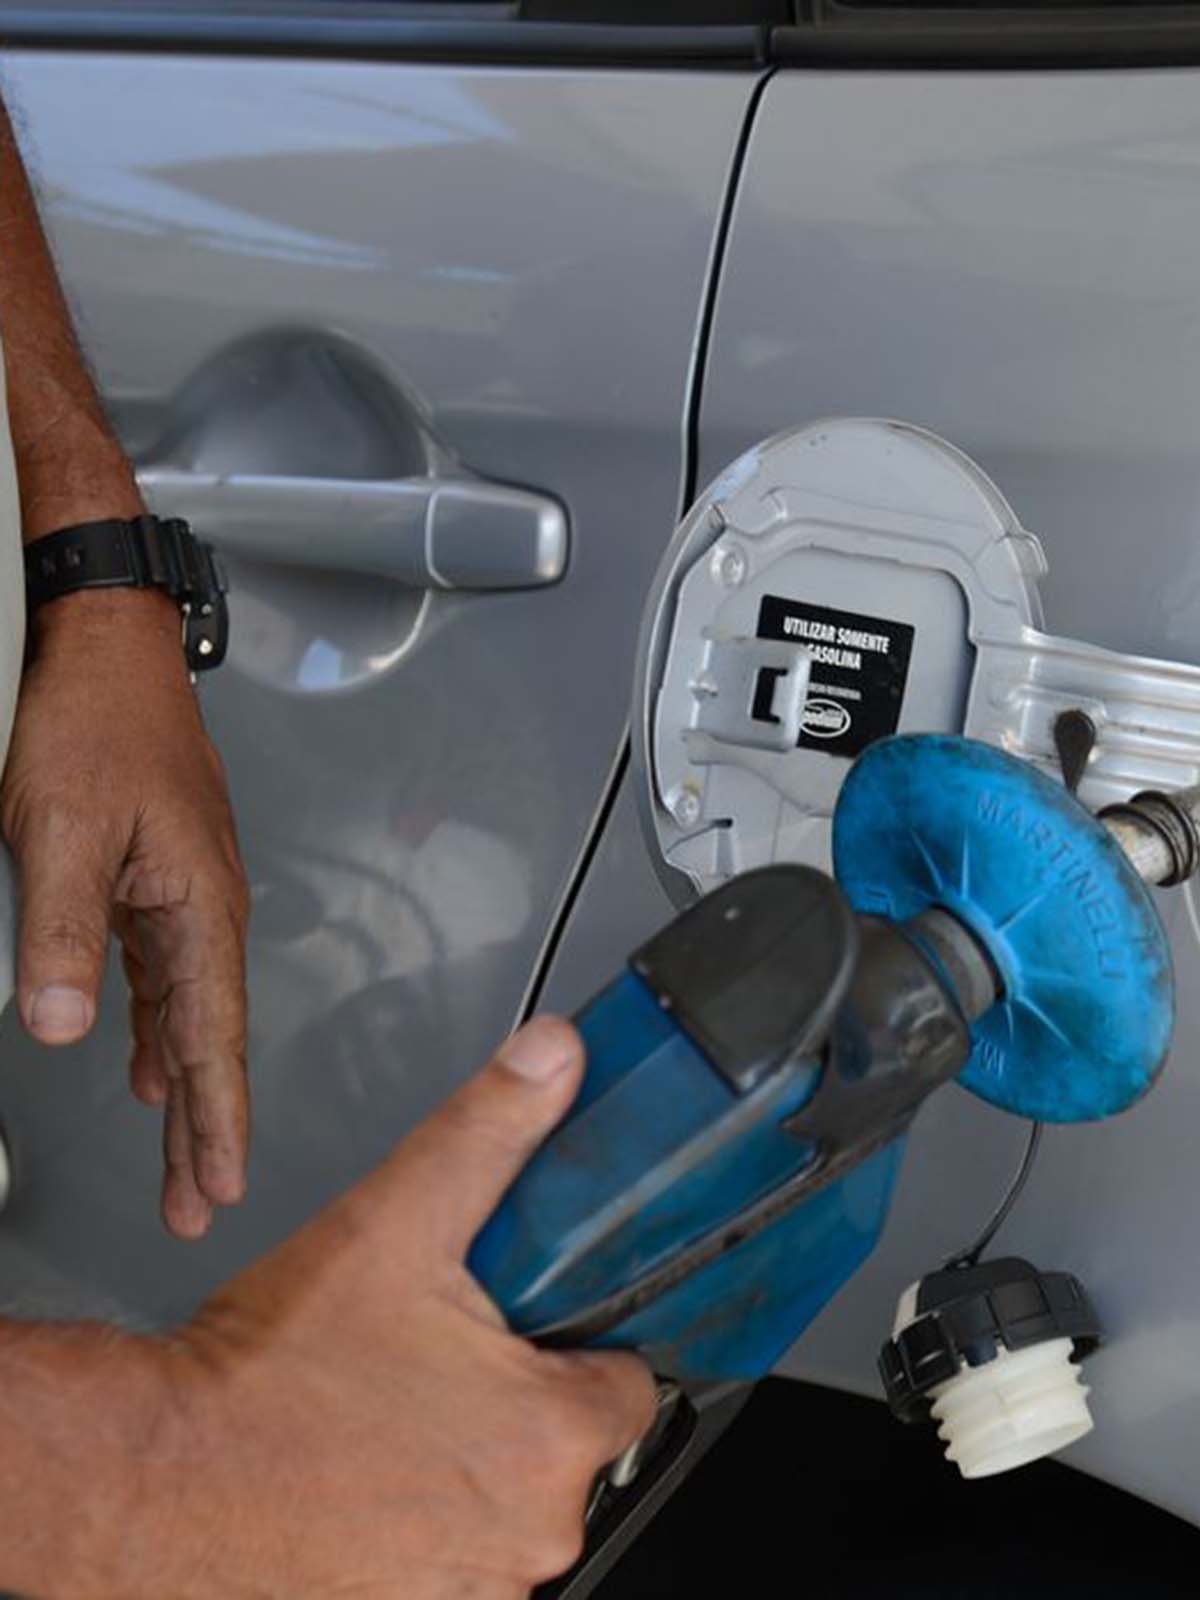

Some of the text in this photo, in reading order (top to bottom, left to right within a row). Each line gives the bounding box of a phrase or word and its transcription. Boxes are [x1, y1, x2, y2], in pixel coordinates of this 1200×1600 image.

[783, 616, 889, 653] UTILIZAR SOMENTE
[977, 789, 1130, 980] MARTINELLI
